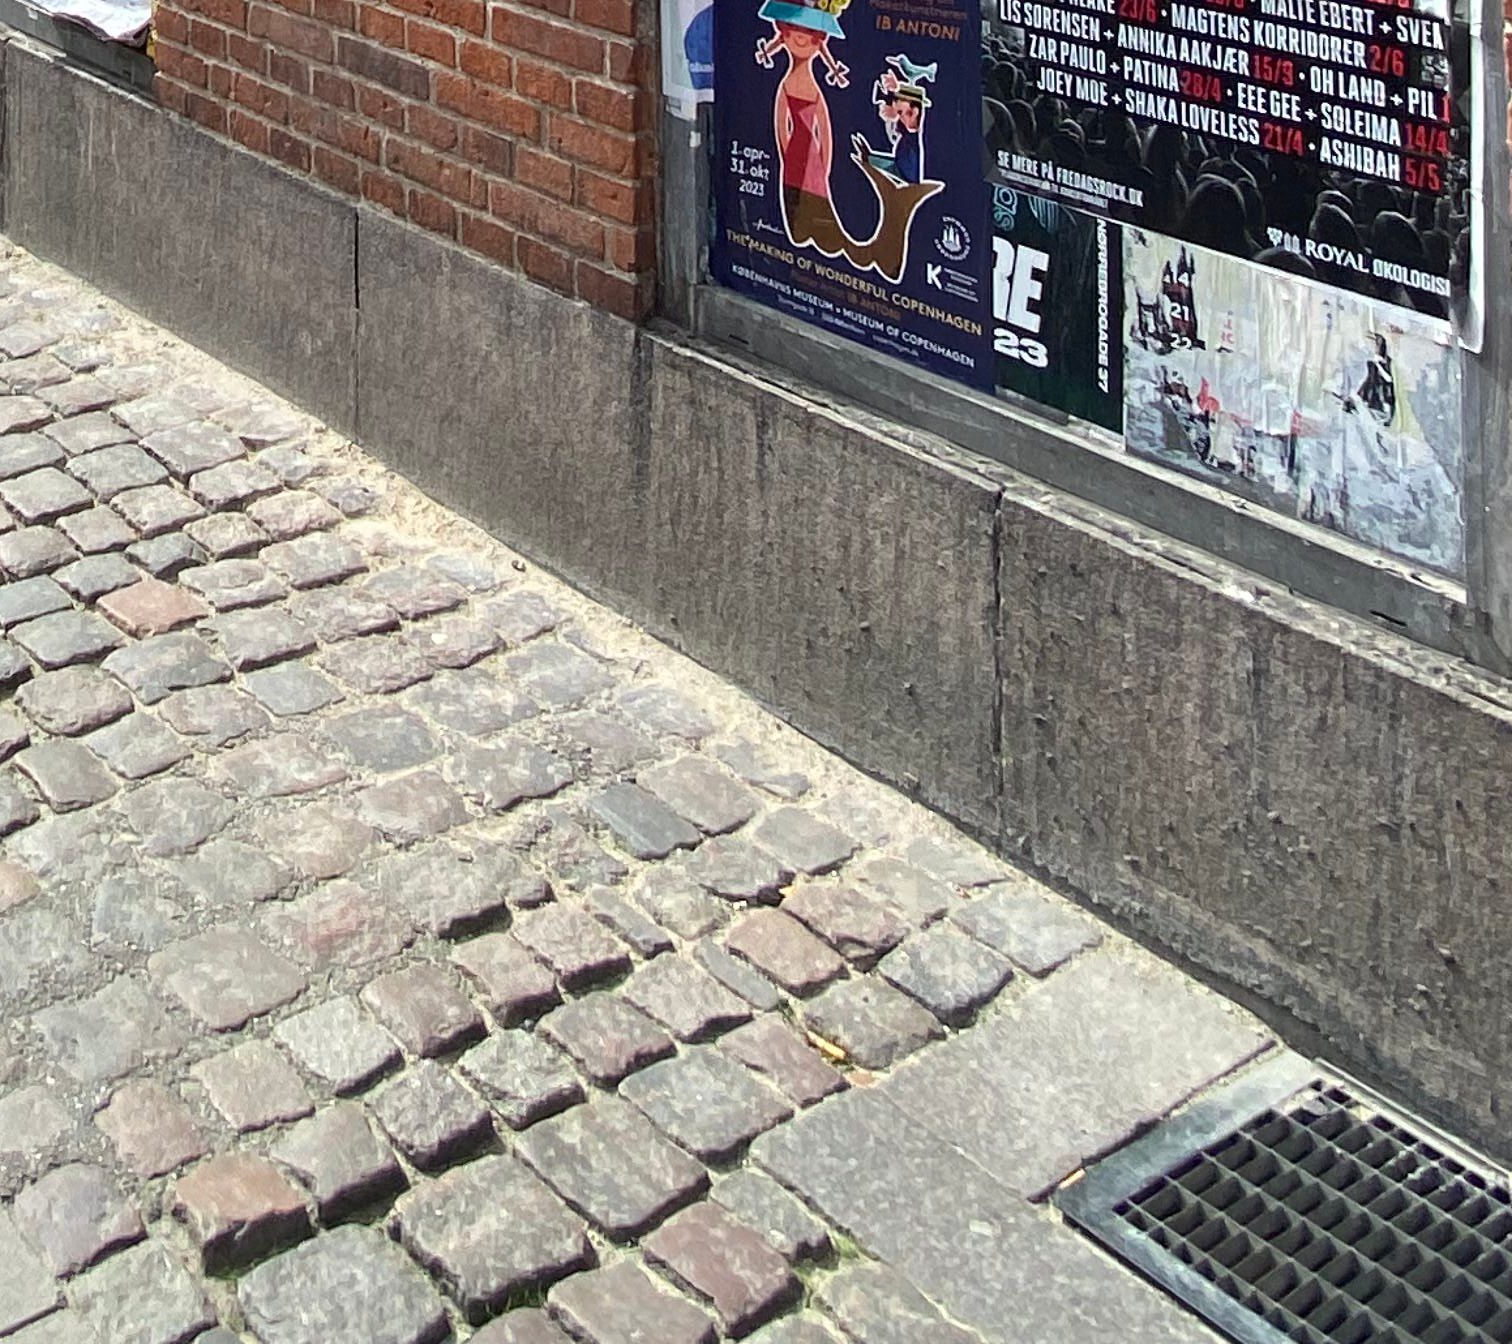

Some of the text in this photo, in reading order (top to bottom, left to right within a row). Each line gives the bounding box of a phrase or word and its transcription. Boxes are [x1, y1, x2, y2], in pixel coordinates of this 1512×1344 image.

[876, 15, 961, 41] IB ANTONI
[1171, 3, 1250, 44] MAGTENS
[1253, 20, 1367, 70] KORRIDORER
[1368, 44, 1405, 78] 2/6
[1320, 0, 1376, 36] EBERT
[1028, 34, 1058, 63] ZAR
[1060, 44, 1106, 75] PAULO
[1123, 56, 1180, 92] PATINA
[1180, 70, 1222, 103] 28/4
[1237, 82, 1267, 114] EEE
[1269, 90, 1302, 123] GEE
[1320, 102, 1402, 148] SOLEIMA
[1404, 122, 1449, 154] 14/4
[1117, 23, 1178, 61] ANNIKA
[1179, 37, 1250, 77] AAKJÆR
[1252, 53, 1294, 86] 15/9
[1310, 66, 1335, 96] OH
[1338, 71, 1386, 108] LAND
[1407, 87, 1437, 120] PIL
[1037, 66, 1073, 98] JOEY
[1075, 75, 1109, 106] MOE
[1125, 87, 1179, 125] SHAKA
[1180, 101, 1260, 146] LOVELESS
[1262, 121, 1304, 156] 21/4
[1319, 136, 1401, 183] ASHIBAH
[1404, 157, 1440, 192] 5/5
[739, 179, 765, 196] 2023
[749, 164, 769, 181] okt
[997, 150, 1010, 169] SE
[1012, 153, 1039, 177] MERE
[1041, 160, 1055, 182] PÅ
[749, 239, 795, 264] MAKING
[796, 256, 813, 271] OF
[814, 262, 889, 301] WONDERFUL
[892, 293, 982, 336] COPENHAGEN
[927, 262, 943, 290] K
[992, 235, 1050, 333] RE
[1305, 238, 1451, 298] ROYAL ØKOLOGIS
[732, 263, 791, 295] KØBENHAVNS
[793, 288, 834, 311] MUSEUM
[842, 307, 884, 331] MUSEUM
[886, 325, 900, 337] OF
[901, 331, 975, 368] COPENHAGEN
[1170, 302, 1189, 321] 21
[1097, 367, 1109, 394] 37
